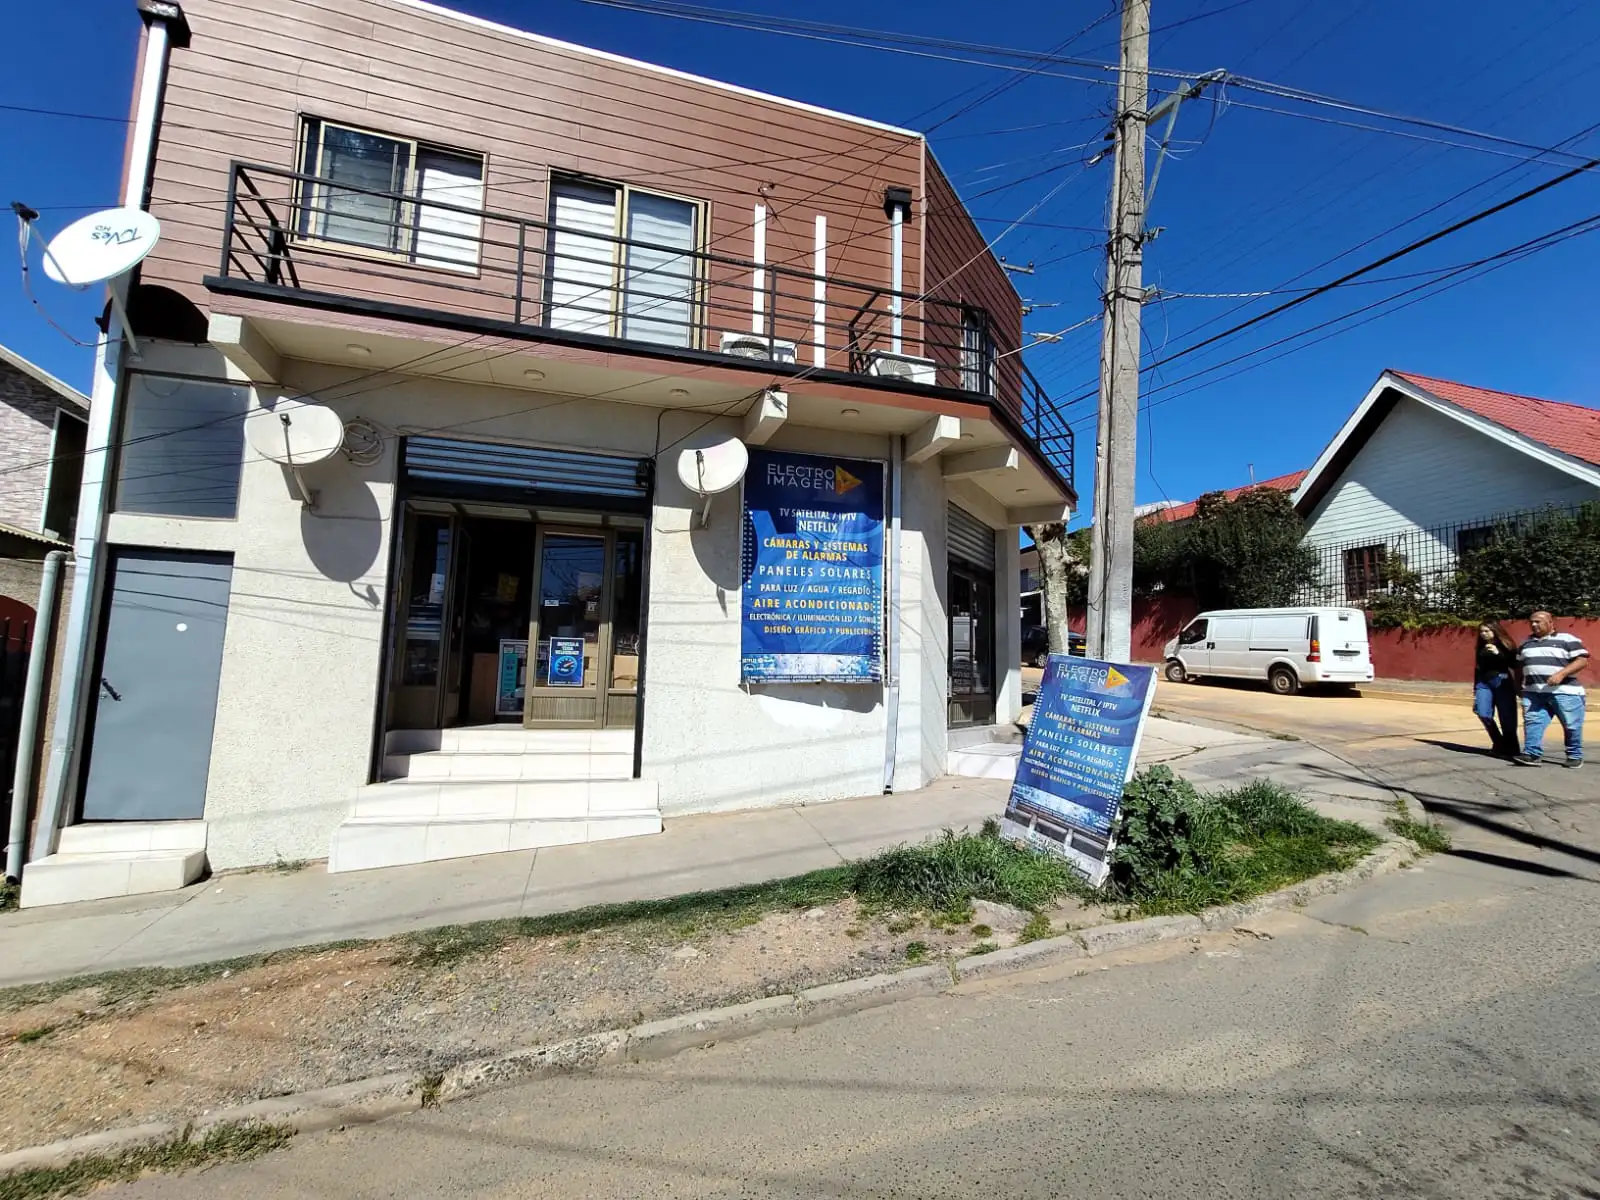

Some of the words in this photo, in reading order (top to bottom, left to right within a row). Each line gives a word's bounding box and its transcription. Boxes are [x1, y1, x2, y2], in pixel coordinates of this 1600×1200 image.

[767, 463, 835, 480] ELECTRO
[767, 475, 835, 490] IMAGEN
[779, 507, 790, 517] TV
[791, 508, 831, 520] SATELITAL
[798, 520, 838, 533] NETFLIX
[763, 536, 811, 549] CÁMARAS
[814, 541, 819, 550] Y
[823, 541, 868, 553] SISTEMAS
[786, 550, 798, 559] DE
[802, 551, 848, 562] ALARMAS
[759, 564, 814, 577] PANELES
[820, 567, 871, 580] SOLARES
[760, 584, 781, 592] PARA
[783, 585, 798, 593] LUZ
[807, 585, 829, 593] AGUA
[838, 585, 871, 595] REGADÍO
[754, 598, 780, 608] AIRE
[764, 624, 792, 633] DISEÑO
[795, 625, 826, 634] GRÁFICO
[1058, 663, 1108, 678] ELECTRO
[1056, 671, 1106, 688] IMAGEN
[1070, 704, 1101, 717] NETFLIX
[1102, 701, 1118, 711] IPTV
[1084, 720, 1121, 735] SISTEMAS
[1037, 728, 1074, 744] PANELES
[1077, 739, 1119, 757] SOLARES
